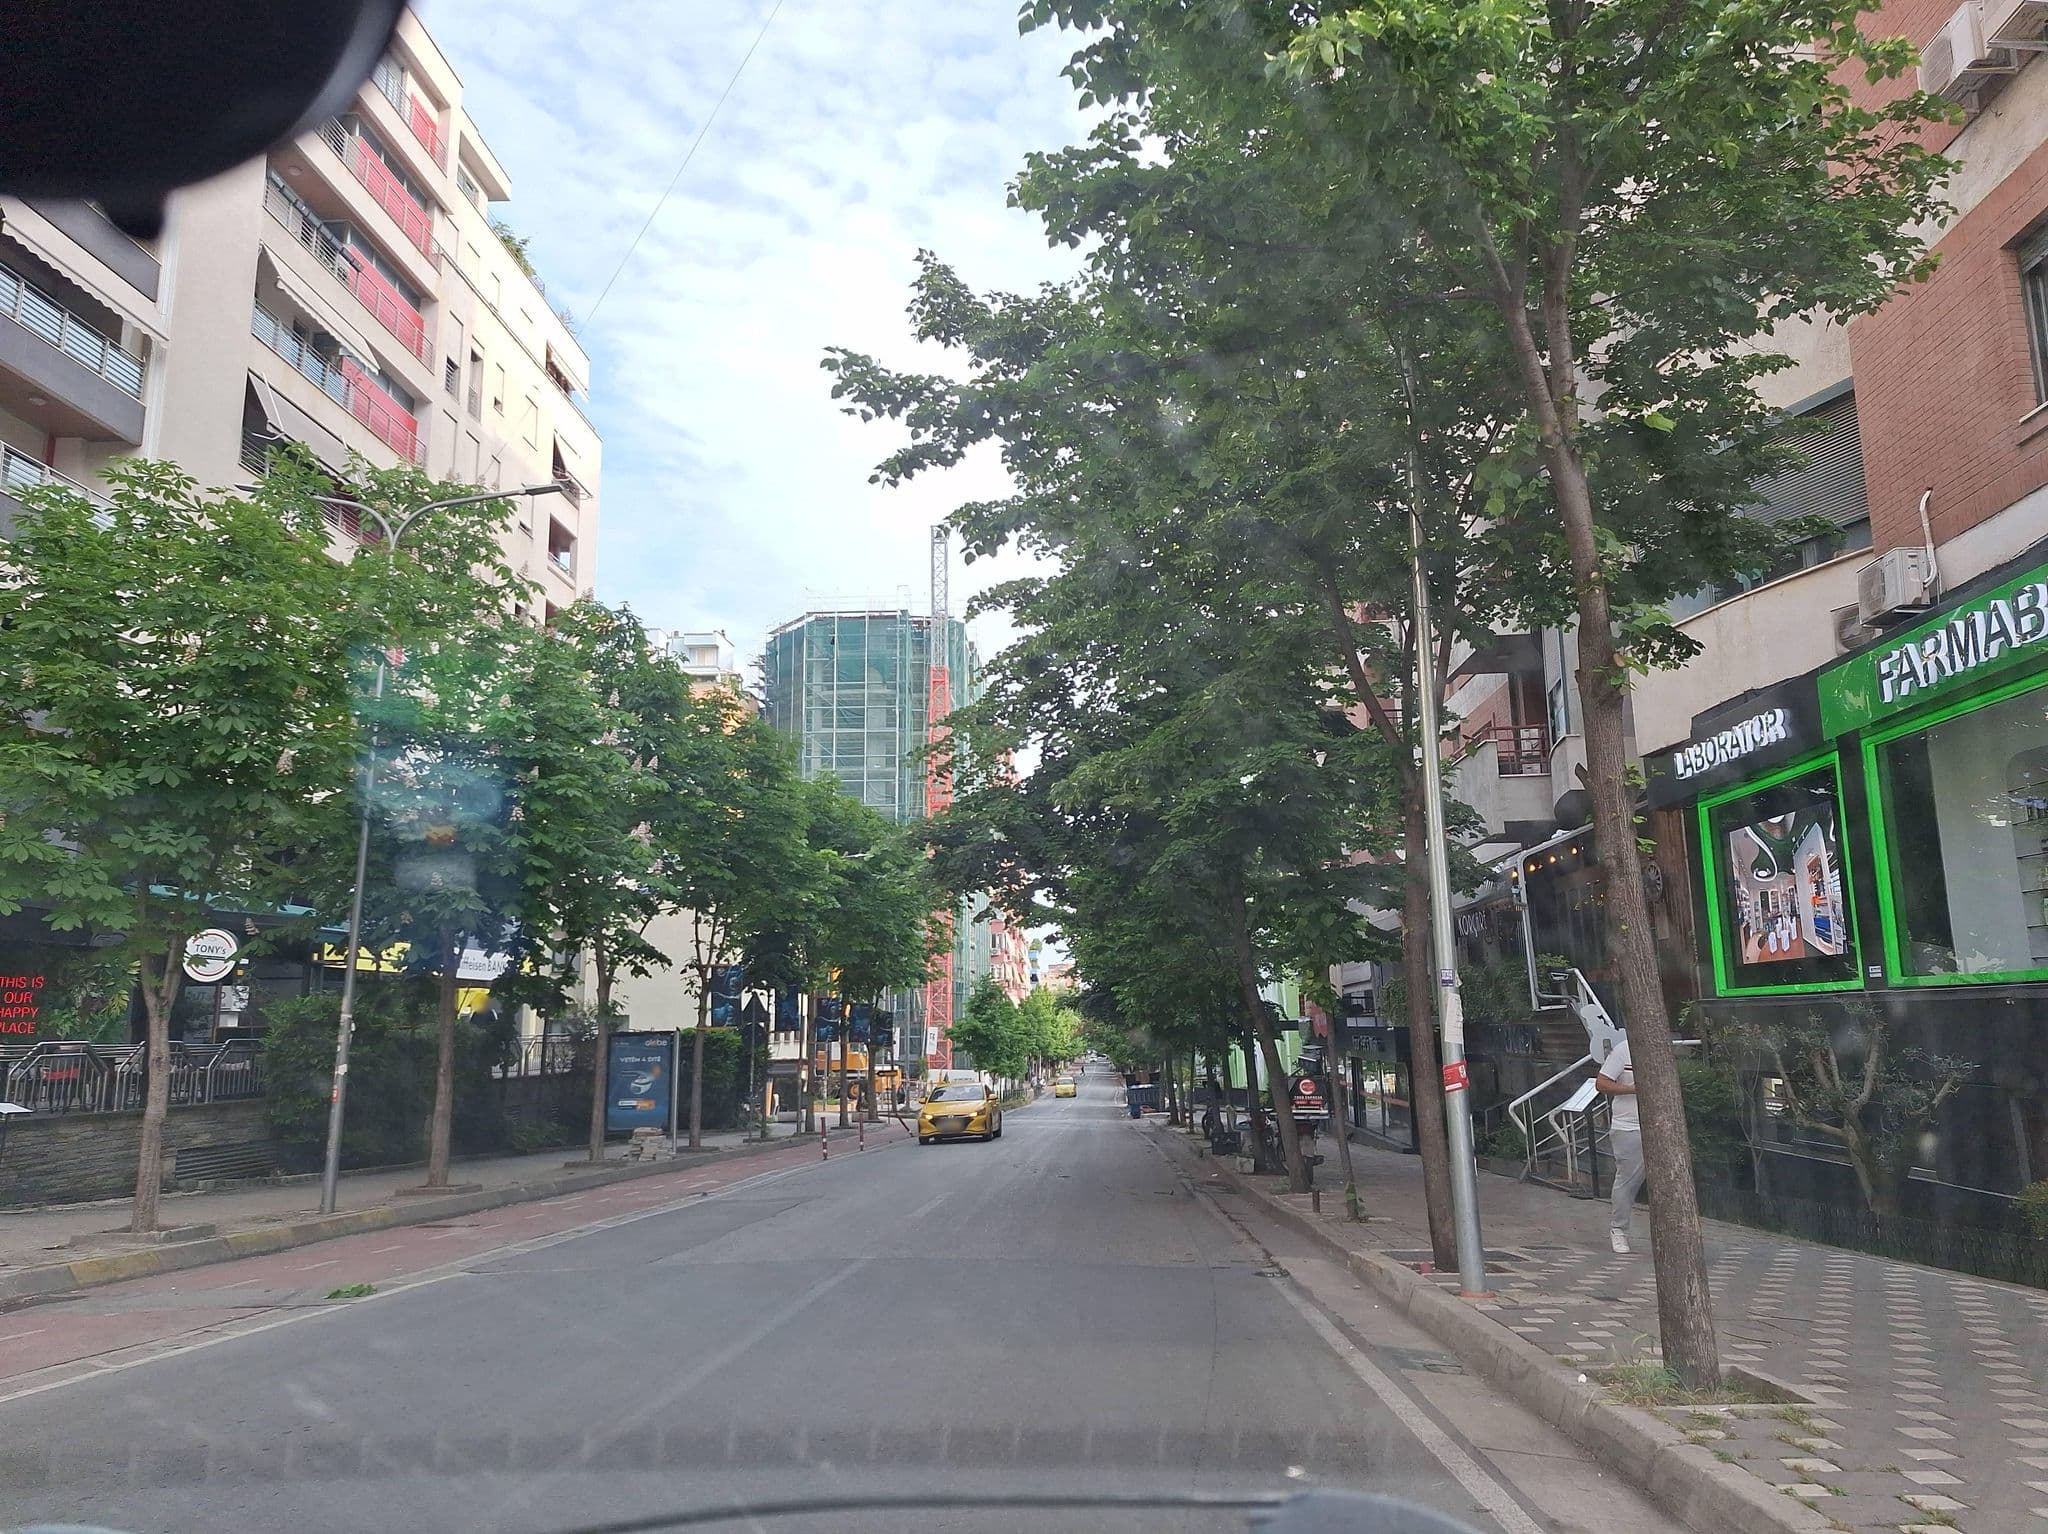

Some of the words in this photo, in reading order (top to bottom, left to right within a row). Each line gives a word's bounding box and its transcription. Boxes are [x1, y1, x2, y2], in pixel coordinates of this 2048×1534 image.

[1877, 582, 2048, 704] FARMAB
[1673, 708, 1788, 780] LABORATOR
[195, 944, 227, 955] TONY's
[487, 959, 506, 972] BAN
[0, 976, 26, 989] THIS
[31, 976, 44, 989] IS
[4, 991, 33, 1004] OUR
[0, 1021, 36, 1034] LACE
